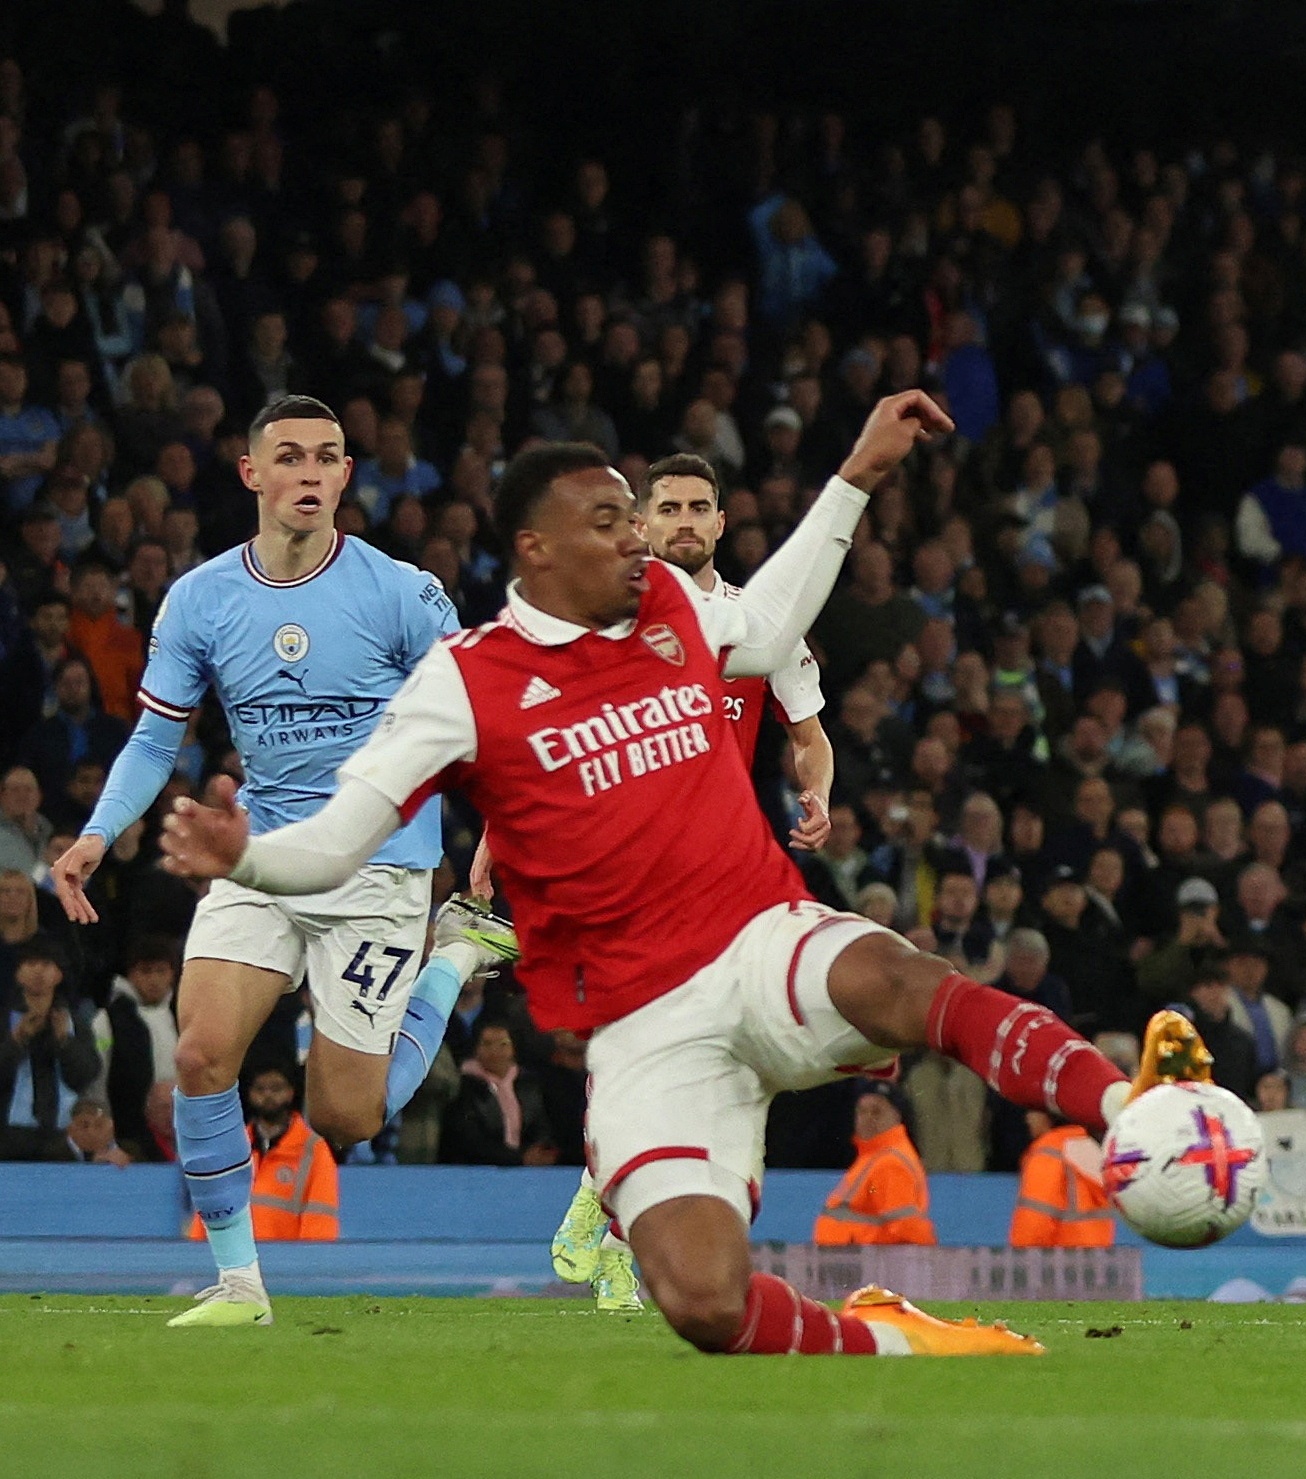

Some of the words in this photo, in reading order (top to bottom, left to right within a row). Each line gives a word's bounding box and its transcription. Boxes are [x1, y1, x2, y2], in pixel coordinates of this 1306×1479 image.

[235, 700, 381, 726] ETIHAD
[257, 723, 354, 748] AIRWAYS
[526, 683, 713, 773] Emirates
[578, 750, 623, 798] FLY
[625, 722, 711, 778] BETTER
[341, 940, 416, 1002] 47
